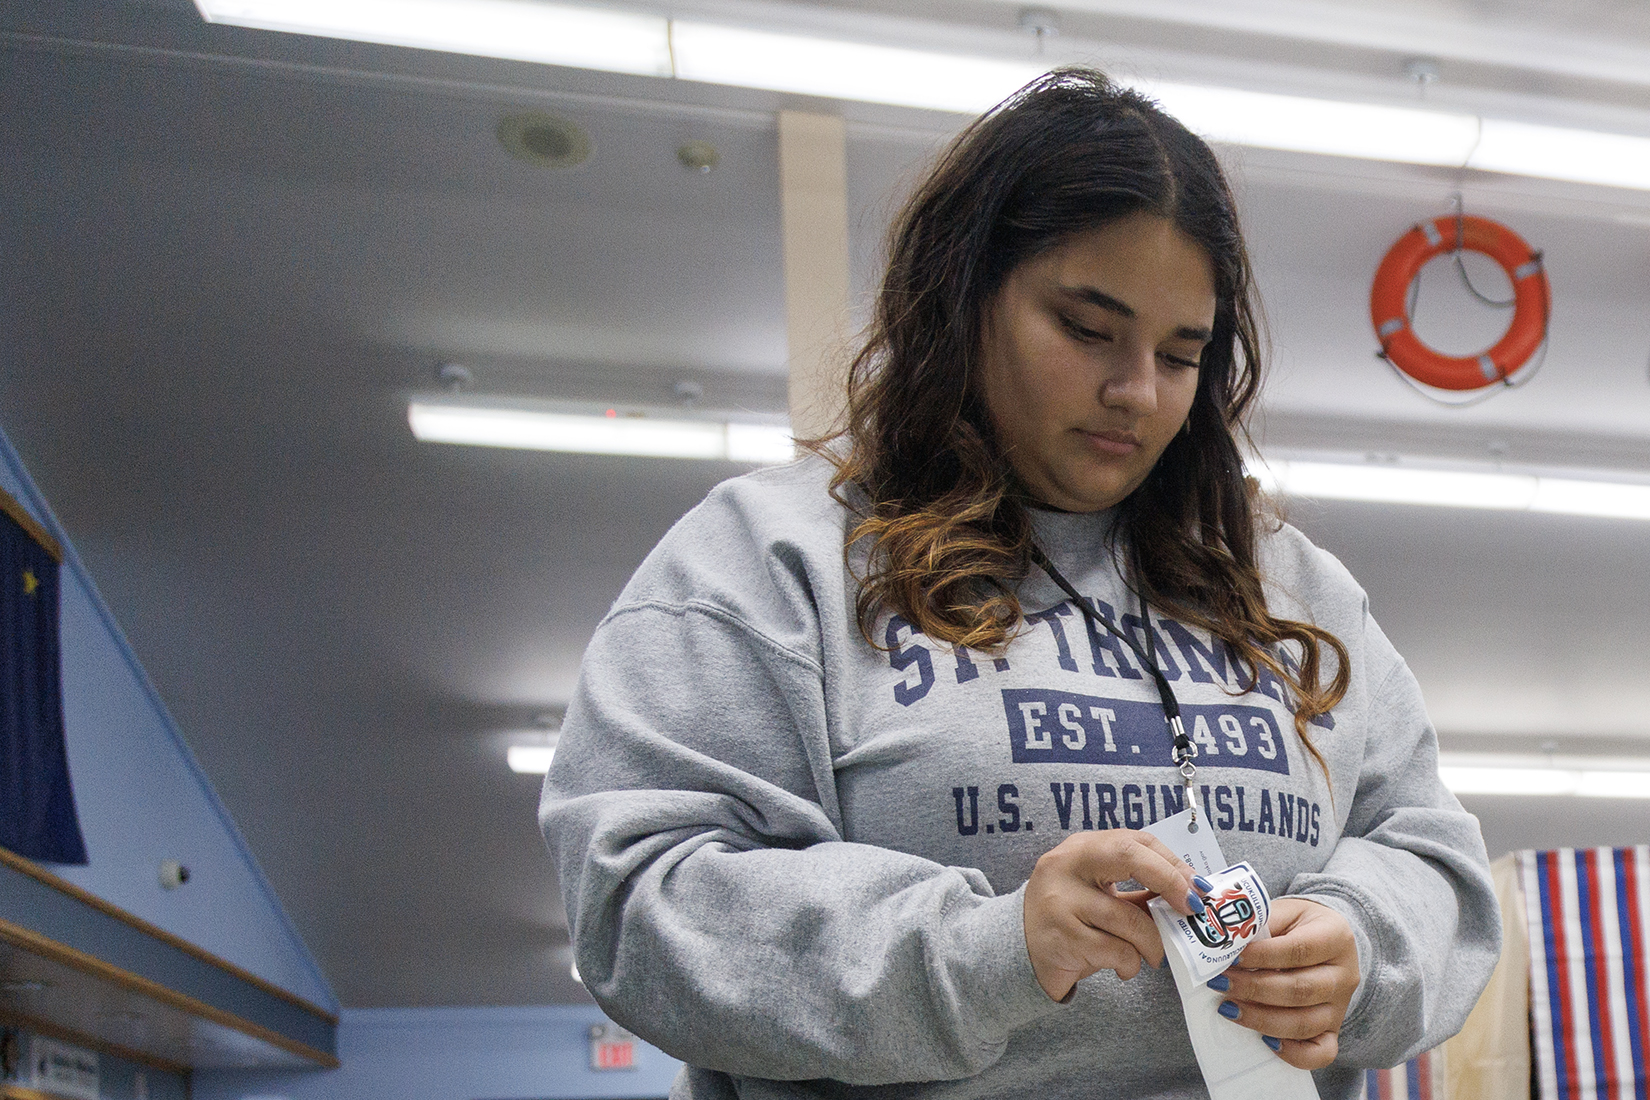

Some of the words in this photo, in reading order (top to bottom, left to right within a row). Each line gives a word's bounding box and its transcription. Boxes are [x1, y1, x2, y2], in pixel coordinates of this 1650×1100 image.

[1018, 701, 1140, 754] EST.
[1164, 713, 1277, 760] 493
[952, 783, 1033, 836] U.S.
[1050, 782, 1184, 831] VIRGIN
[1200, 785, 1320, 847] ISLANDS
[1177, 918, 1194, 940] VOTED!
